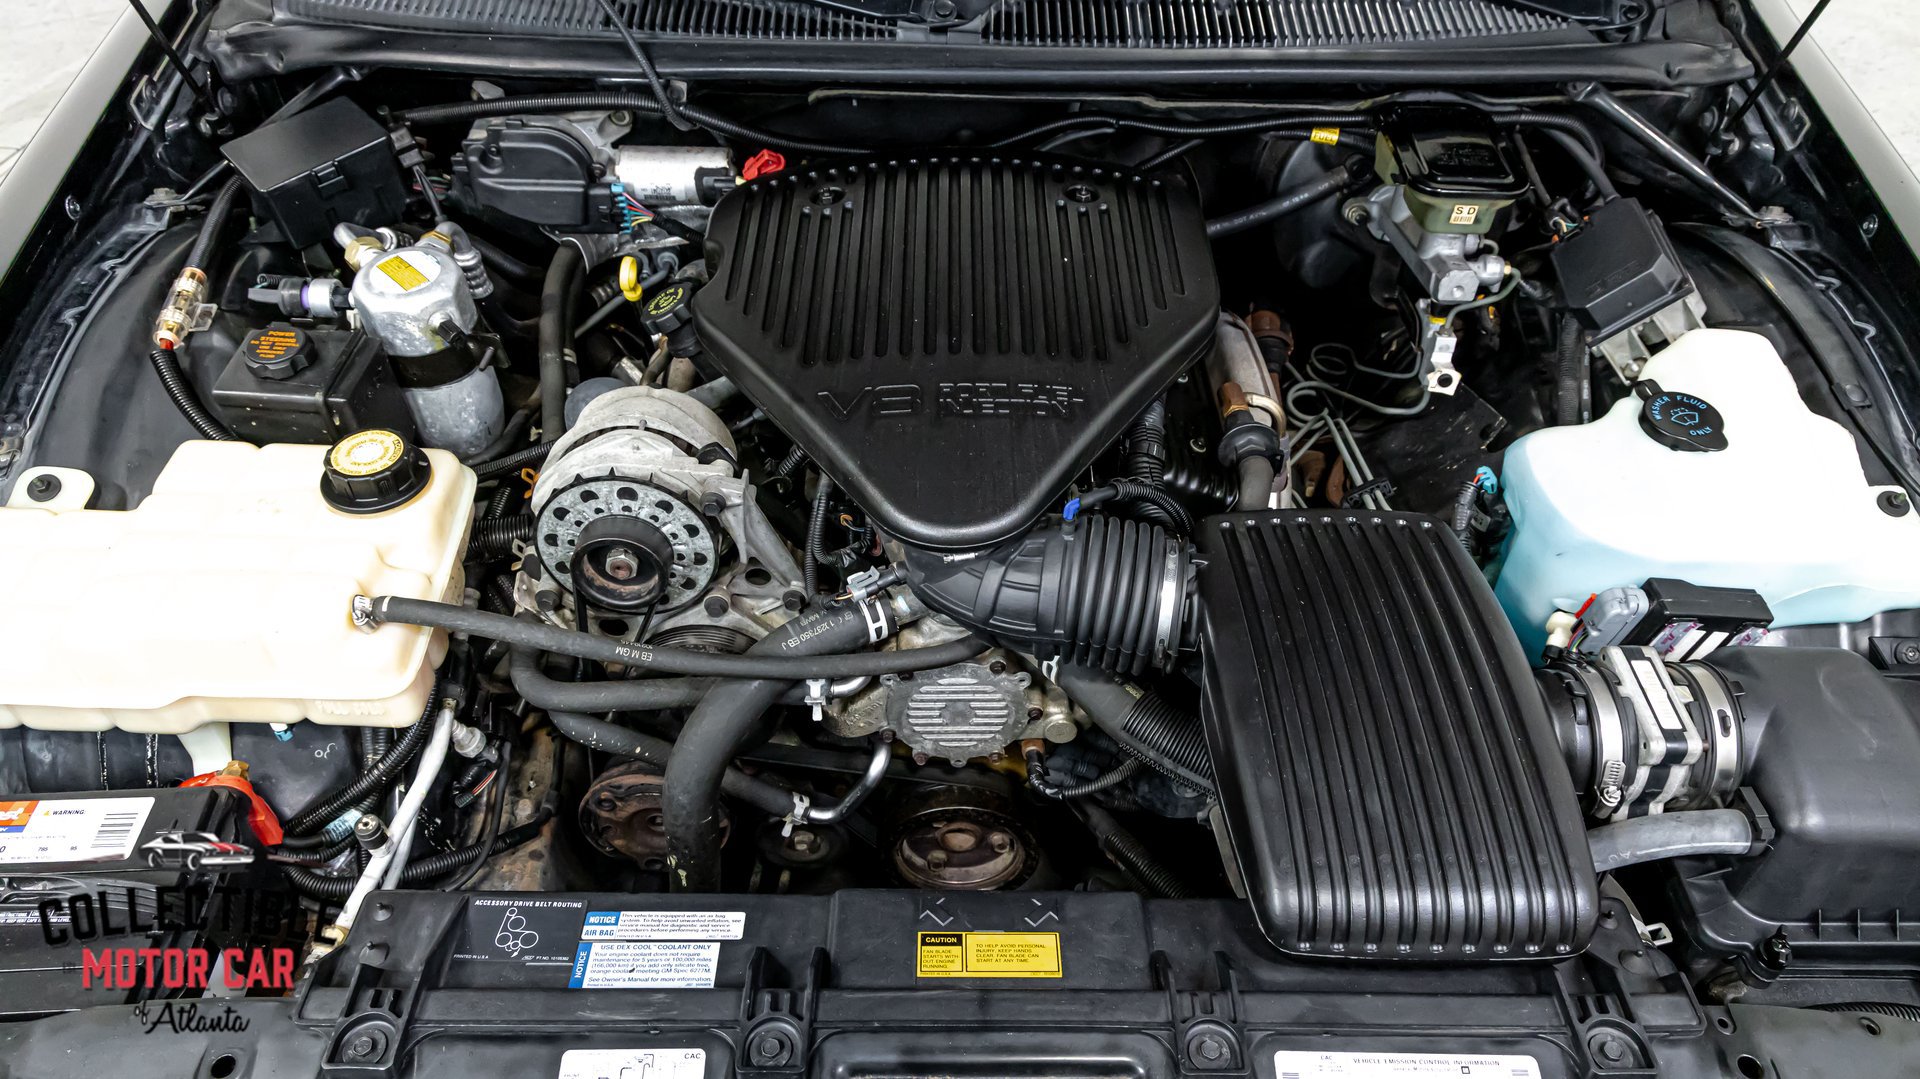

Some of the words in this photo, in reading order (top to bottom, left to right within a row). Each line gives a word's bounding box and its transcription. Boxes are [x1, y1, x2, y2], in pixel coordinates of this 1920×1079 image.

[1455, 206, 1464, 215] S
[1467, 206, 1476, 215] D
[1651, 396, 1671, 420] WASHER
[1676, 395, 1707, 410] FLUID
[1689, 426, 1713, 436] ONLY
[615, 646, 630, 656] GM
[631, 650, 640, 659] M
[588, 916, 616, 924] NOTICE
[574, 950, 588, 978] NOTICE
